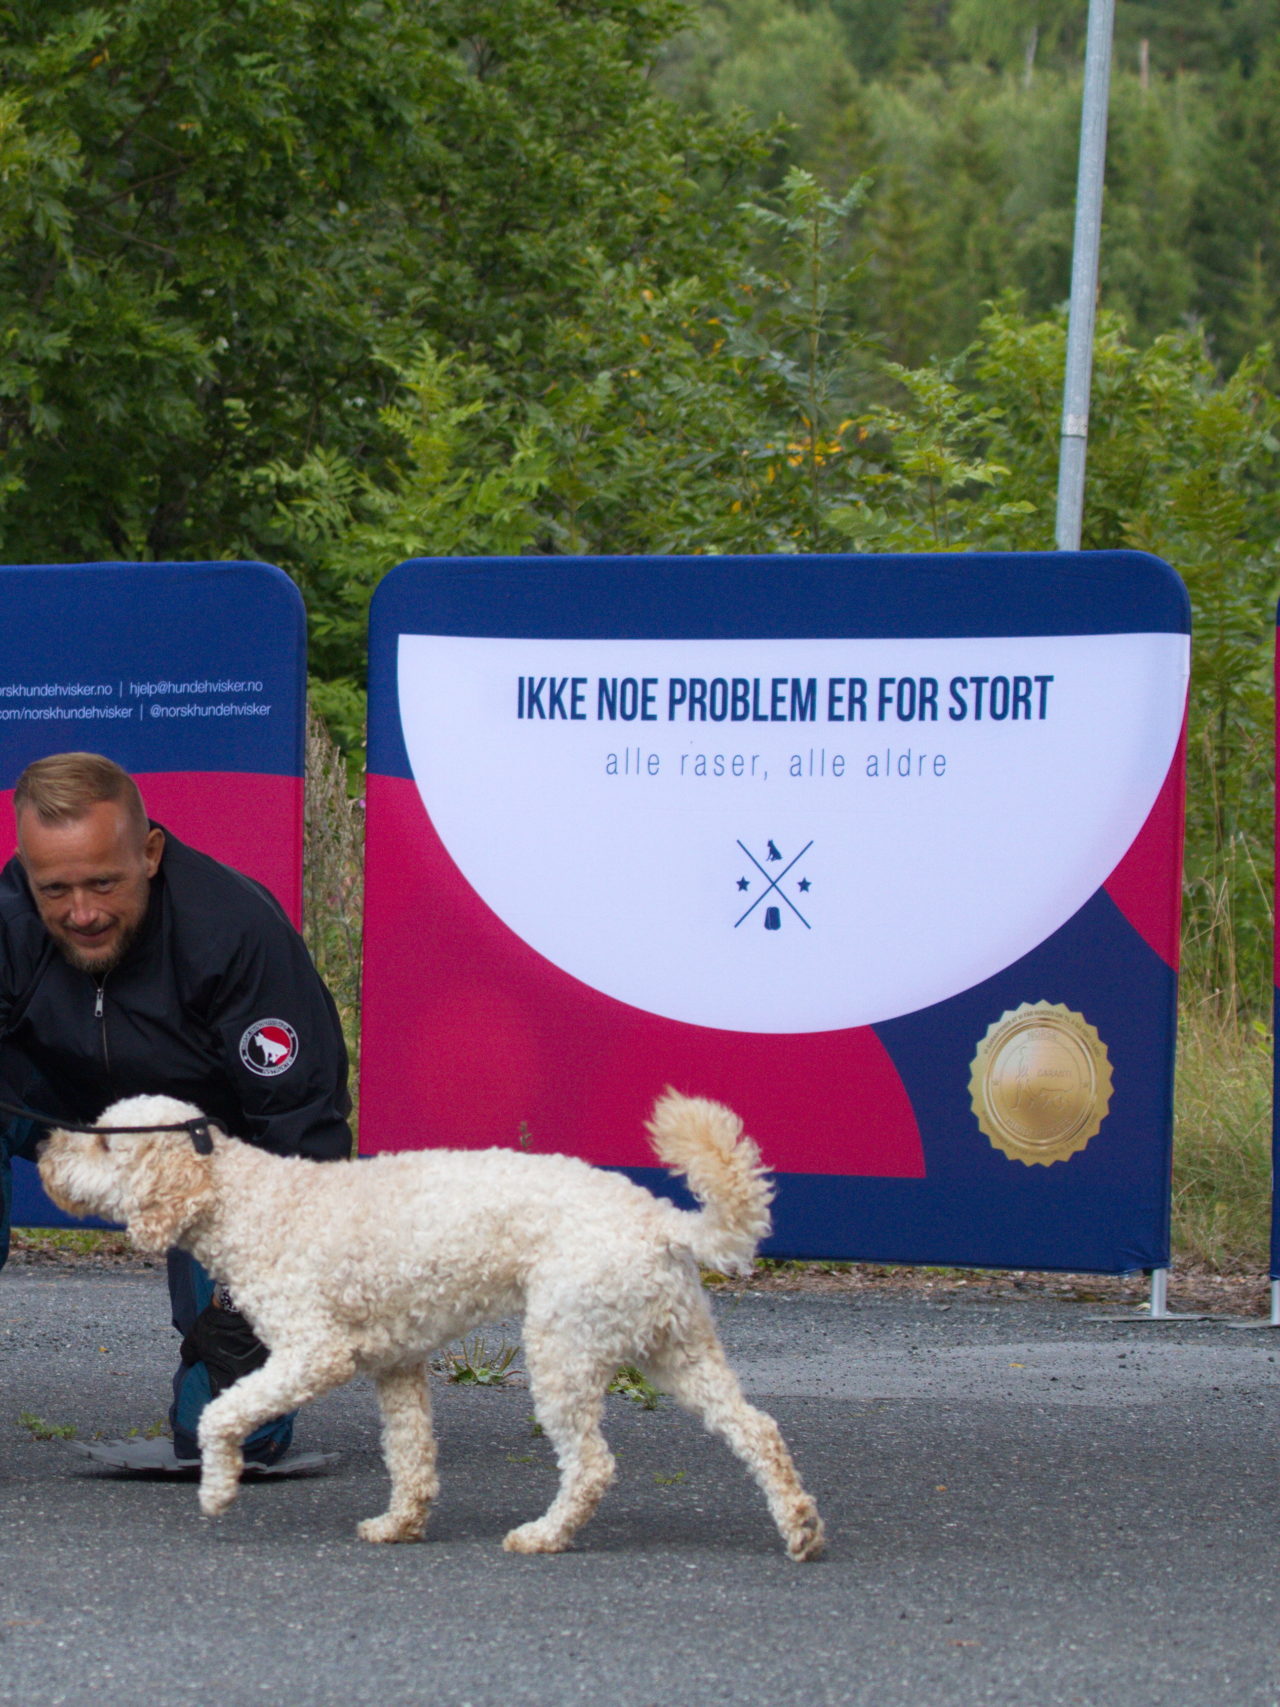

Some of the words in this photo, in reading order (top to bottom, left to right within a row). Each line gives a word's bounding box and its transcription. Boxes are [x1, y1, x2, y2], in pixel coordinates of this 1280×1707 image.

[129, 679, 264, 698] hjelp@hundehvisker.no
[517, 676, 588, 720] IKKE
[597, 677, 659, 721] NOE
[668, 677, 817, 722] PROBLEM
[827, 677, 868, 722] ER
[877, 676, 939, 722] FOR
[948, 675, 1055, 721] STORT
[150, 702, 272, 718] @norskhundehvisker
[605, 747, 661, 776] alle
[680, 753, 769, 781] raser,
[789, 748, 846, 777] alle
[865, 748, 947, 777] aldre
